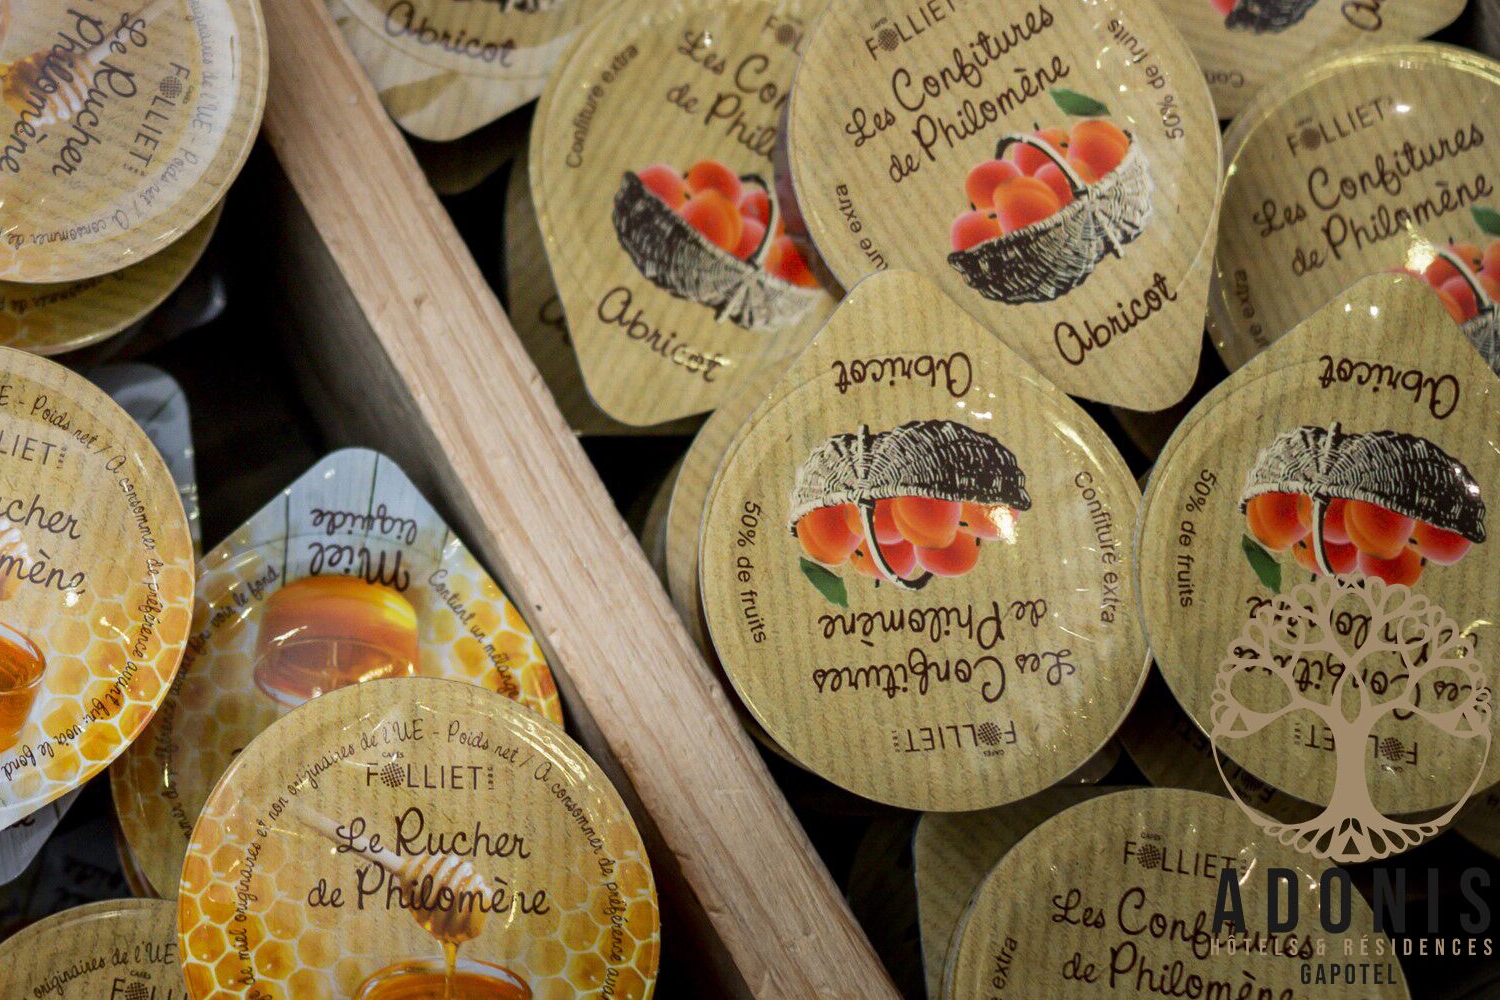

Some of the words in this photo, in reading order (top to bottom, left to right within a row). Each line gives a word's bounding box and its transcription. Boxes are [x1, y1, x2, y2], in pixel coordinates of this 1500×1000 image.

[109, 12, 148, 55] Le
[384, 0, 518, 68] Abricot
[678, 29, 725, 77] Les
[1107, 19, 1145, 64] fruits
[666, 84, 698, 115] de
[846, 108, 896, 148] Les
[892, 4, 1054, 112] Confitures
[1145, 64, 1166, 91] de
[53, 60, 138, 176] Rucher
[566, 83, 604, 169] Confiture
[601, 45, 639, 83] extra
[889, 154, 920, 182] de
[912, 56, 1070, 161] Philomène
[1253, 200, 1306, 238] Les
[1308, 122, 1485, 211] Confitures
[836, 184, 862, 234] extra
[1292, 251, 1324, 277] de
[1322, 174, 1494, 261] Philomène
[597, 286, 724, 384] Abricot
[1054, 271, 1179, 366] Abricot
[832, 352, 973, 398] Abricot
[1319, 355, 1460, 420] Abricot
[31, 395, 72, 431] Poids
[72, 429, 101, 449] net
[119, 478, 155, 552] consommer
[1185, 469, 1217, 513] 50%
[311, 503, 418, 546] liquide
[737, 500, 761, 547] 50%
[1075, 471, 1119, 565] Confiture
[1100, 571, 1119, 624] extra
[1180, 521, 1196, 548] de
[148, 558, 164, 576] de
[309, 542, 409, 592] Miel
[737, 555, 754, 582] de
[1176, 553, 1195, 608] fruits
[132, 582, 163, 658] préférence
[428, 568, 471, 624] Contient
[740, 589, 766, 643] fruits
[1011, 599, 1048, 627] de
[818, 599, 1005, 650] Philomène
[812, 647, 1005, 703] Confitures
[1015, 649, 1076, 686] Les
[37, 740, 55, 758] le
[53, 725, 83, 748] voir
[1, 744, 37, 781] fond
[268, 796, 289, 822] non
[360, 733, 377, 750] de
[448, 720, 489, 750] Poids
[494, 744, 518, 764] net
[551, 782, 604, 855] consommer
[335, 816, 384, 854] Le
[395, 807, 531, 859] Rucher
[308, 878, 345, 907] de
[355, 860, 549, 915] Philomène
[1051, 888, 1105, 929] Les
[33, 956, 105, 999] originaires
[112, 948, 129, 966] de
[992, 936, 1018, 990] extra
[1062, 952, 1097, 984] de
[1109, 939, 1293, 1000] Philomène
